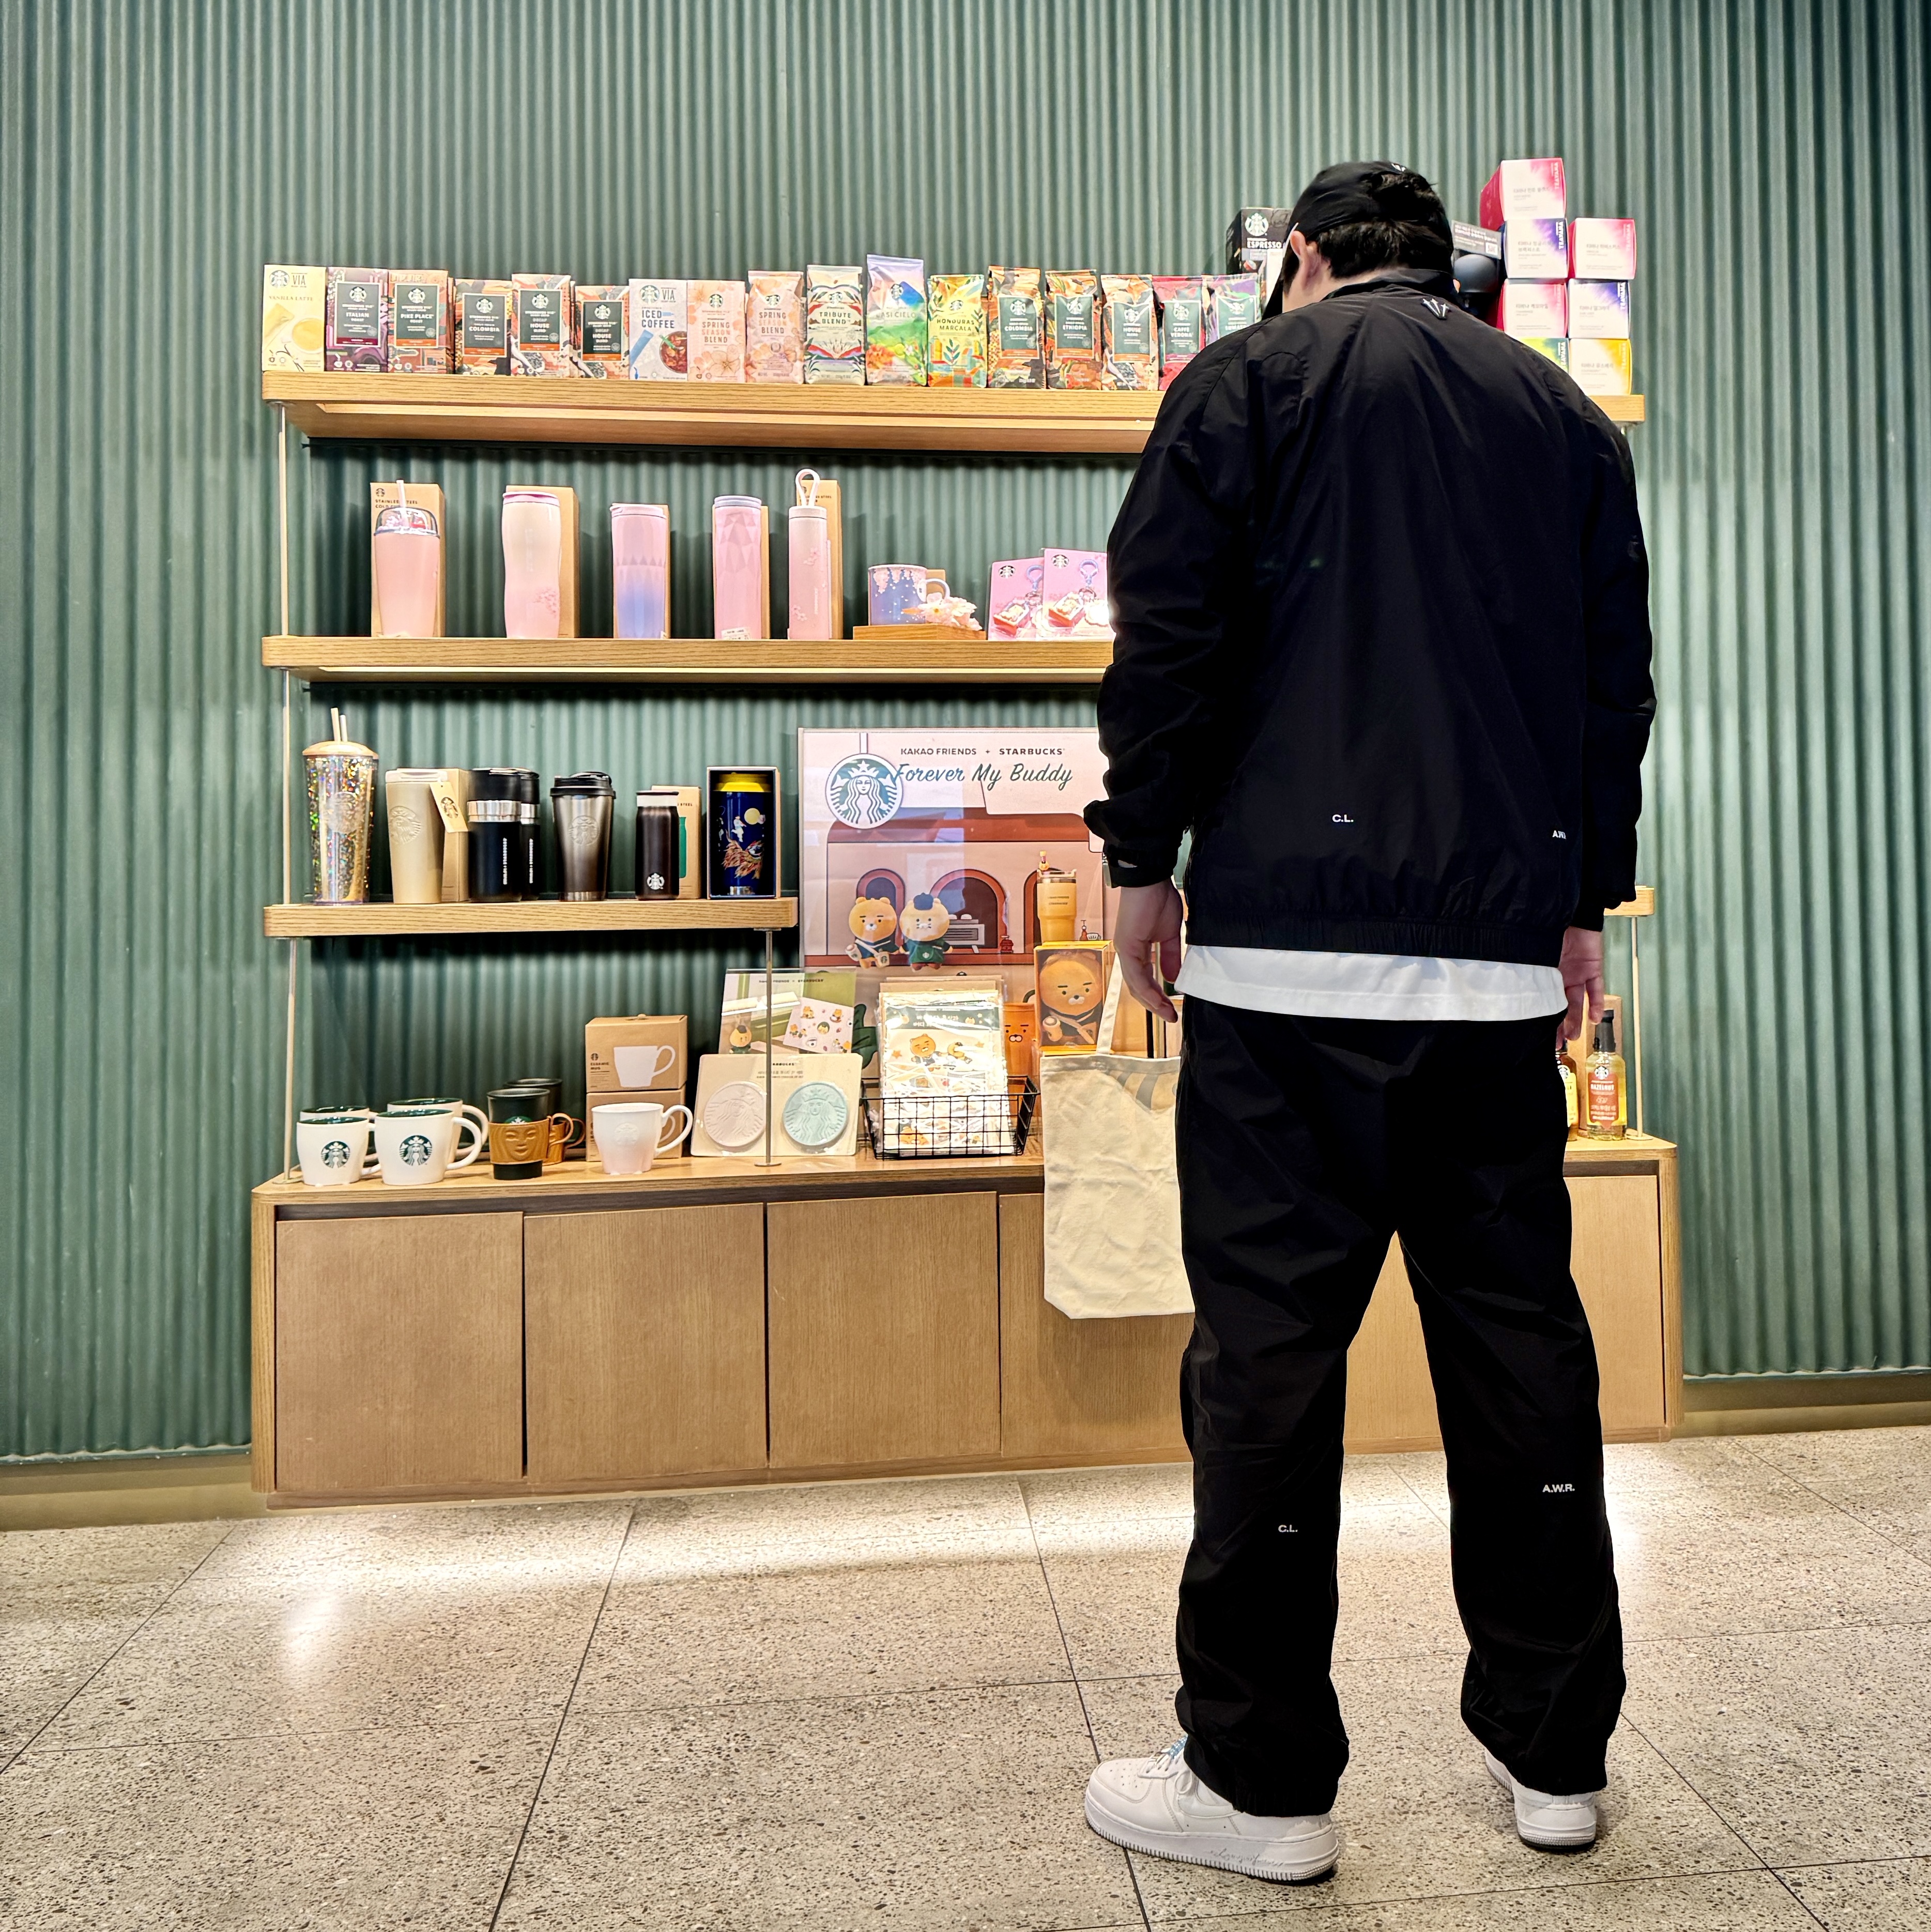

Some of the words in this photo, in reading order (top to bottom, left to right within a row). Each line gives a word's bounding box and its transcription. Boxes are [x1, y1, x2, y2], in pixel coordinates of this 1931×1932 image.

[293, 274, 305, 285] VIA
[662, 289, 675, 300] VIA
[642, 310, 662, 318] ICED
[641, 319, 675, 329] COFFEE
[893, 763, 965, 782] Forever
[971, 763, 1002, 791] My
[1010, 763, 1073, 791] Buddy
[1332, 814, 1354, 823] C.L.
[1542, 1483, 1575, 1493] A.W.R.
[1278, 1524, 1298, 1533] C.L.
